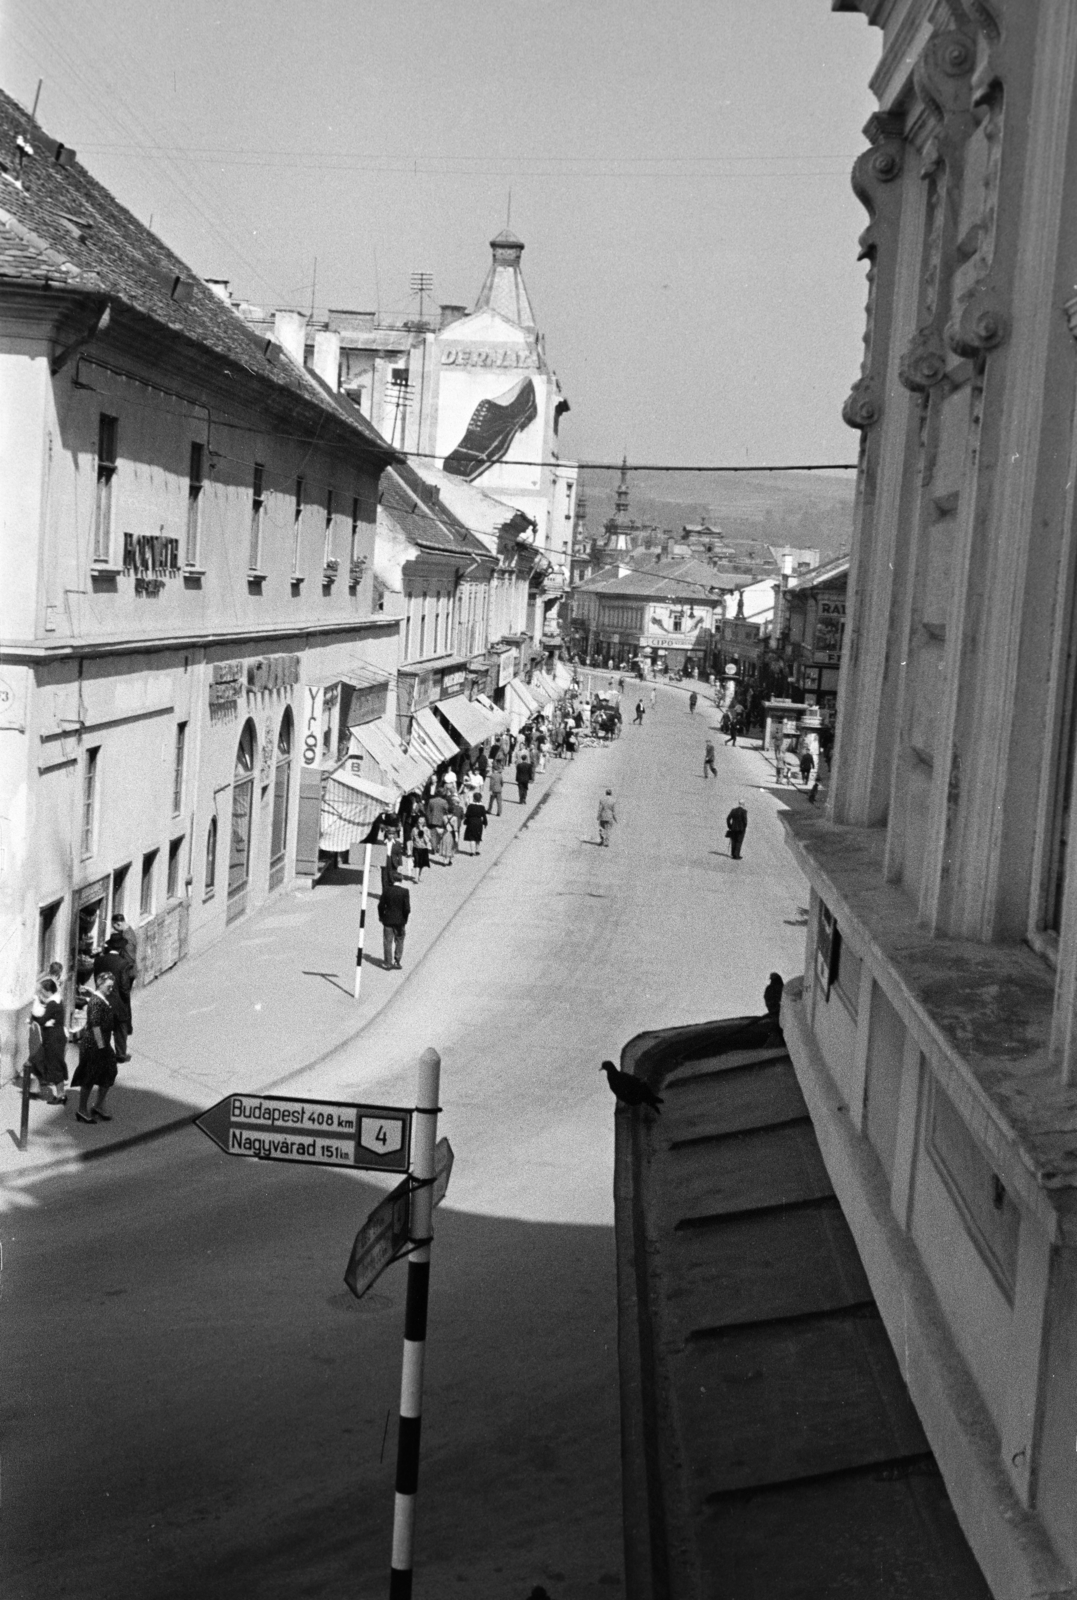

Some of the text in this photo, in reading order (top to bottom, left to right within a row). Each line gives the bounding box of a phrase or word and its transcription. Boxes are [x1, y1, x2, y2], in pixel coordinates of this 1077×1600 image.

[231, 1099, 354, 1129] Budapest 408 km
[231, 1131, 317, 1157] Nagyvárad
[375, 1125, 388, 1146] 4
